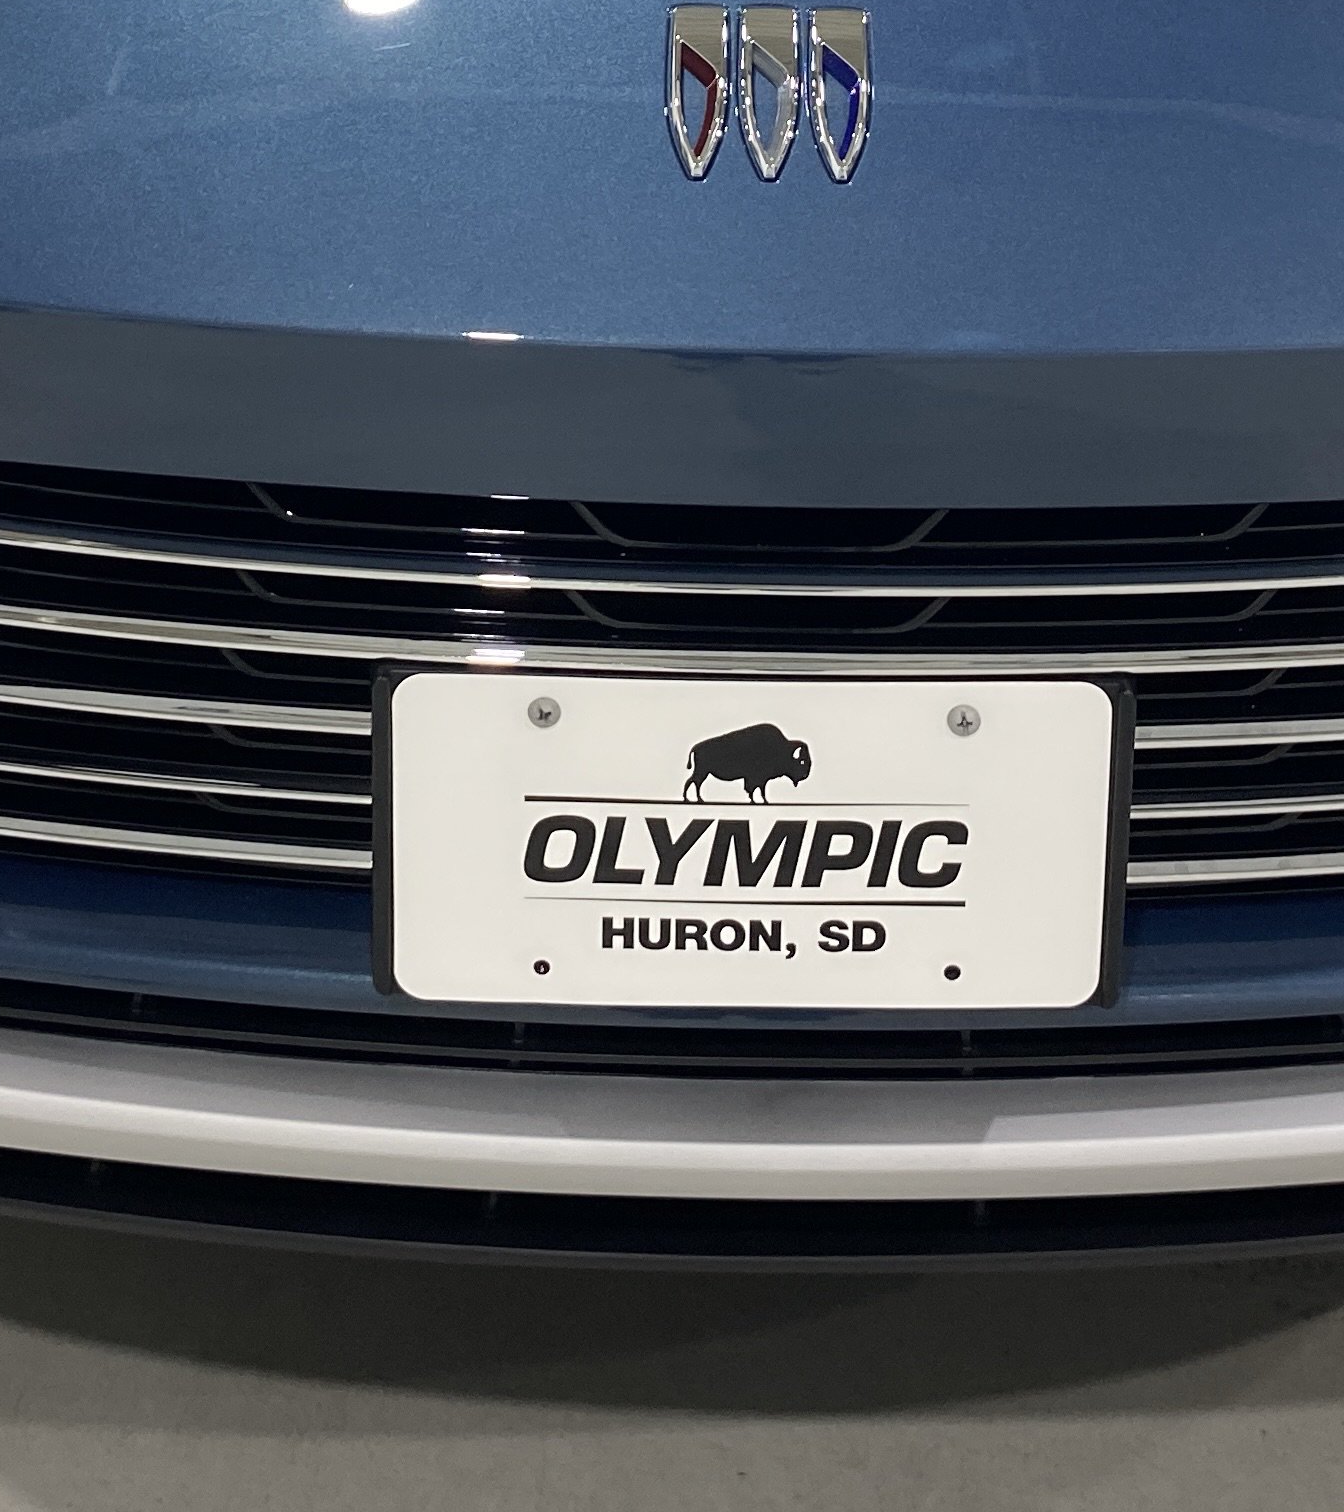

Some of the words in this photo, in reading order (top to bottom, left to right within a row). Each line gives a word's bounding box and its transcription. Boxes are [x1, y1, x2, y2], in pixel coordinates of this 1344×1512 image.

[523, 814, 968, 888] OLYMPIC
[601, 916, 797, 960] HURON,
[818, 918, 887, 953] SD
